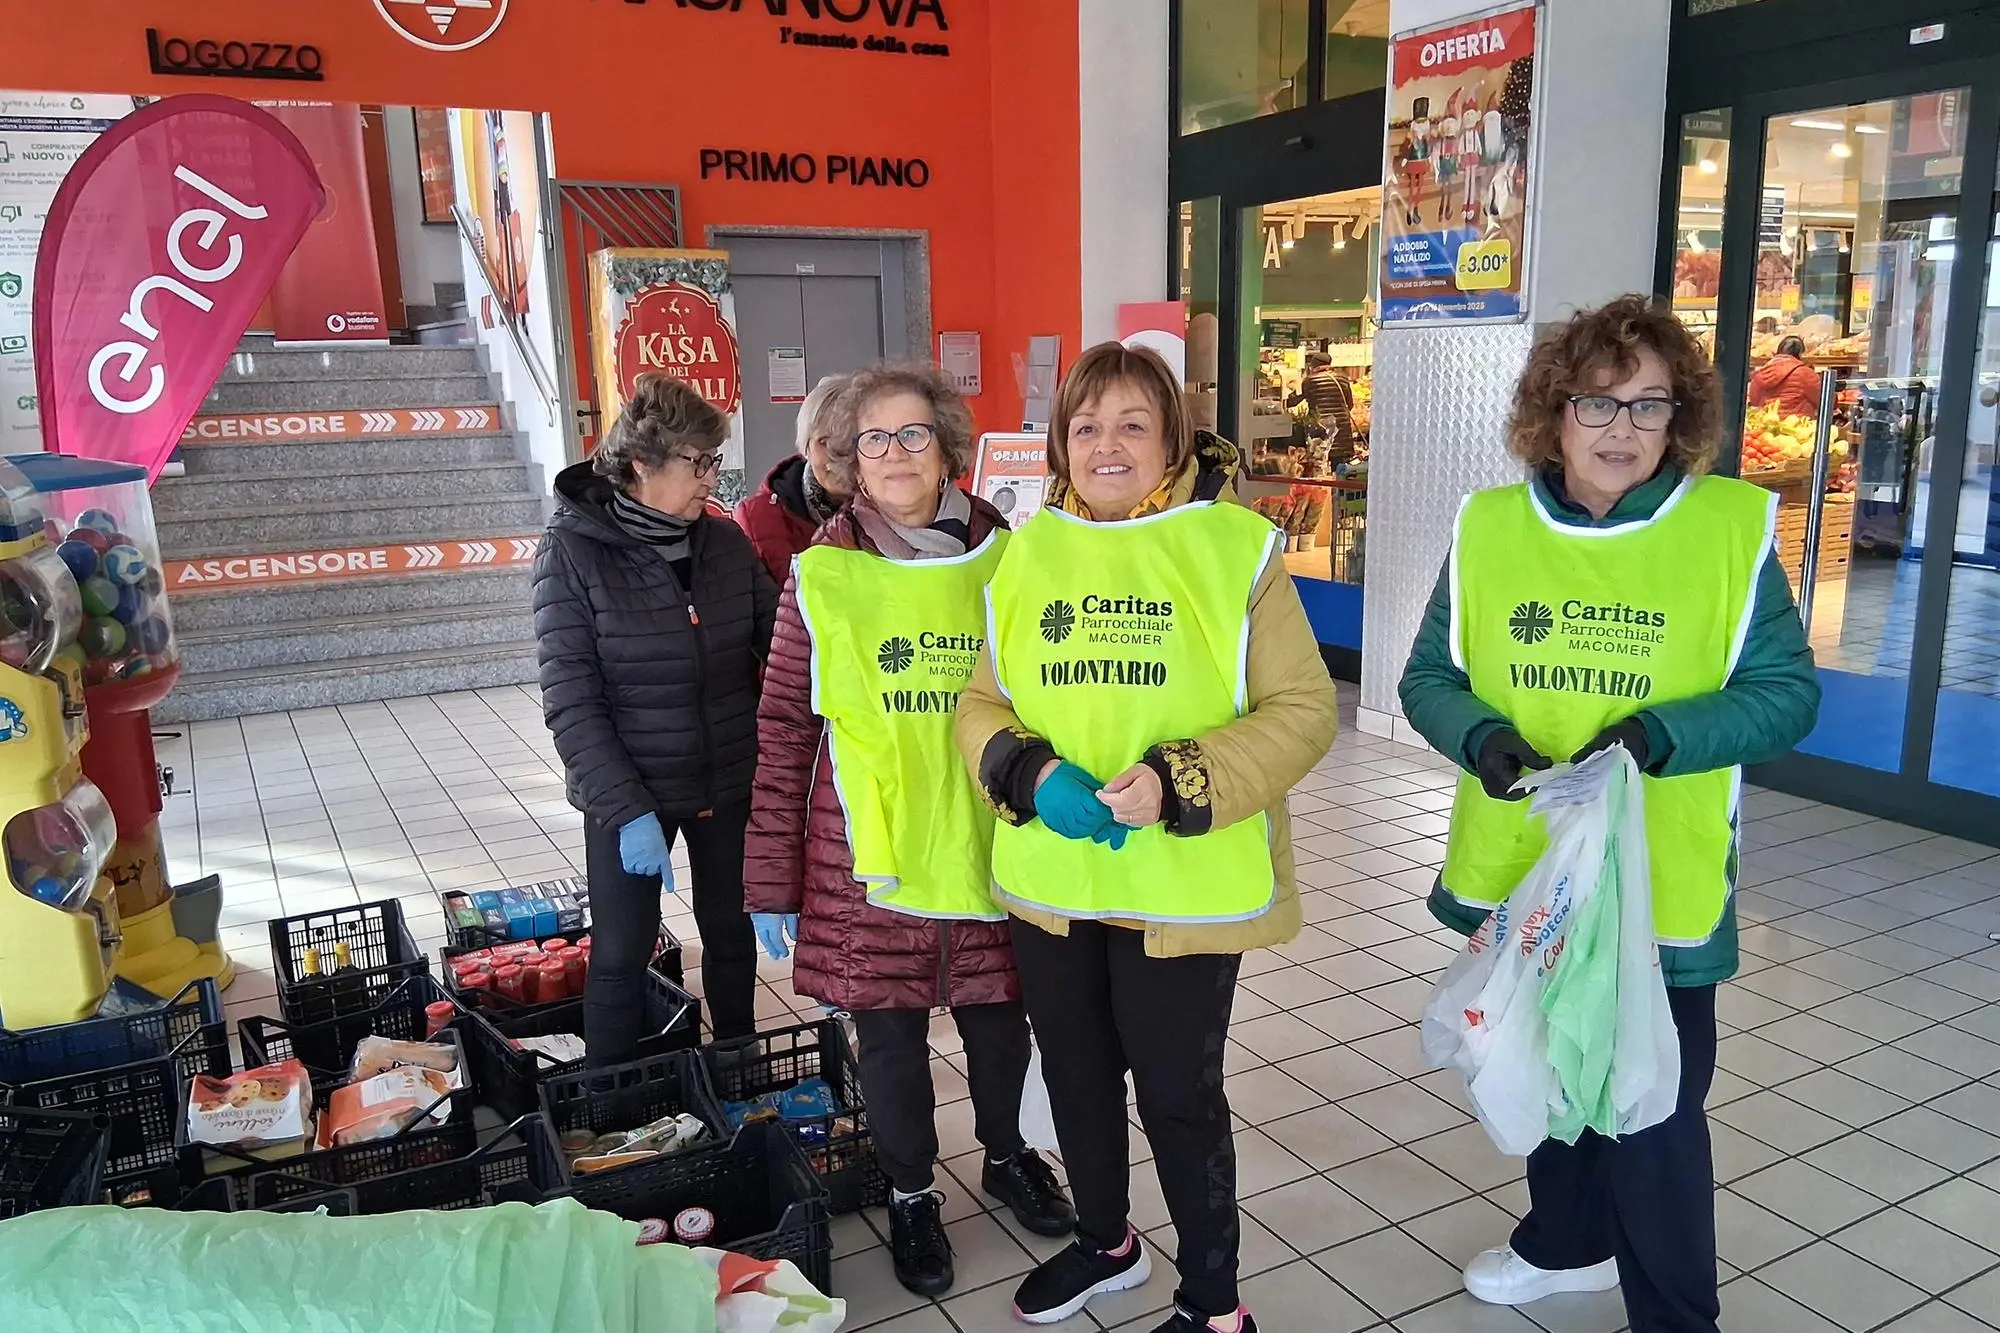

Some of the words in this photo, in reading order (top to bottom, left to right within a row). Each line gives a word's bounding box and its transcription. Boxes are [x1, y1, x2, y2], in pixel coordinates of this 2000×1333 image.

[146, 28, 323, 81] LOGOZZO
[863, 35, 907, 54] della
[1420, 27, 1505, 67] OFFERTA
[22, 152, 65, 160] NUOVO
[700, 148, 816, 184] PRIMO
[826, 155, 929, 188] PIANO
[1393, 252, 1431, 264] NATALIZIO
[88, 164, 268, 414] enel
[668, 323, 687, 335] LA
[636, 332, 719, 368] KASA
[668, 366, 689, 377] DEI
[177, 550, 389, 585] ASCENSORE
[1081, 594, 1173, 617] Caritas
[1561, 600, 1665, 628] Caritas
[1081, 616, 1173, 632] Parrocchiale
[1560, 621, 1665, 644] Parrocchiale
[1088, 632, 1162, 646] MACOMER
[1568, 639, 1651, 658] MACOMER
[1040, 659, 1167, 687] VOLONTARIO
[1509, 663, 1652, 700] VOLONTARIO
